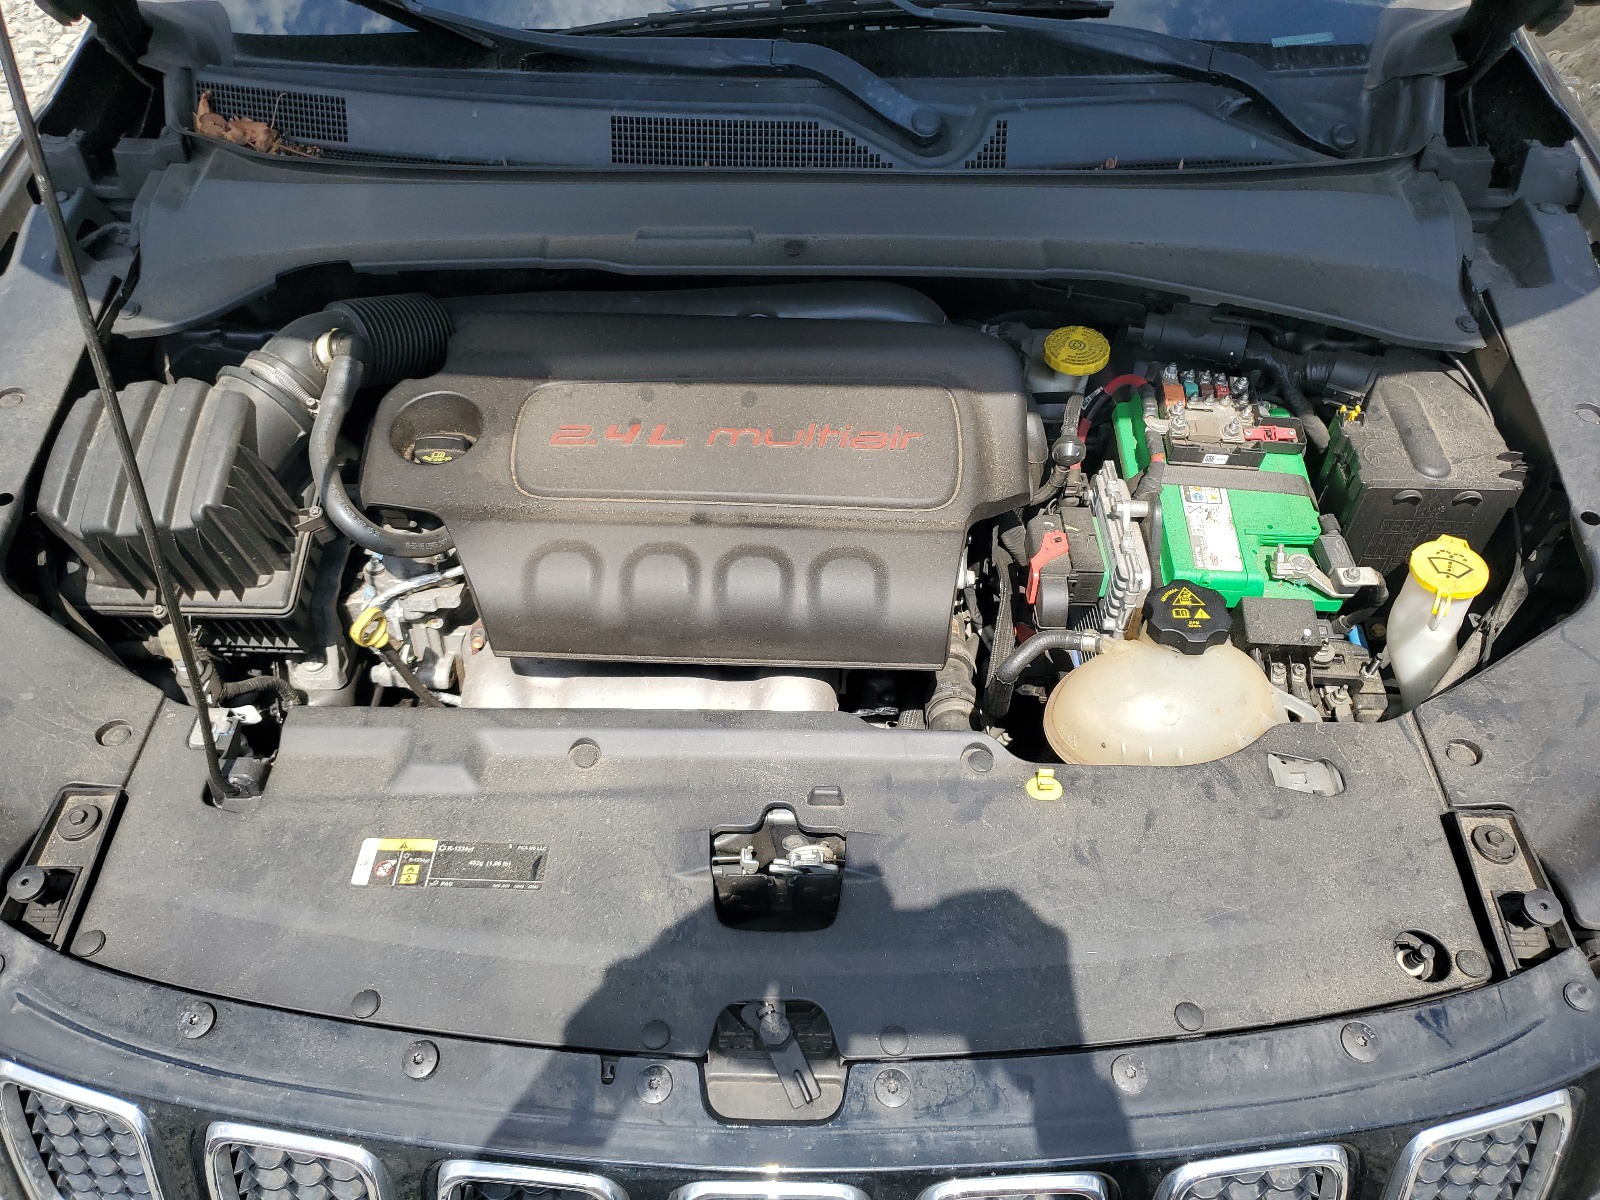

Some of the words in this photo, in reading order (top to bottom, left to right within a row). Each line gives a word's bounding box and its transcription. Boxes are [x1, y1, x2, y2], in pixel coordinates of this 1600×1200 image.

[549, 424, 686, 447] 2.4L
[707, 425, 924, 451] multiair
[447, 845, 475, 853] R-1234yf
